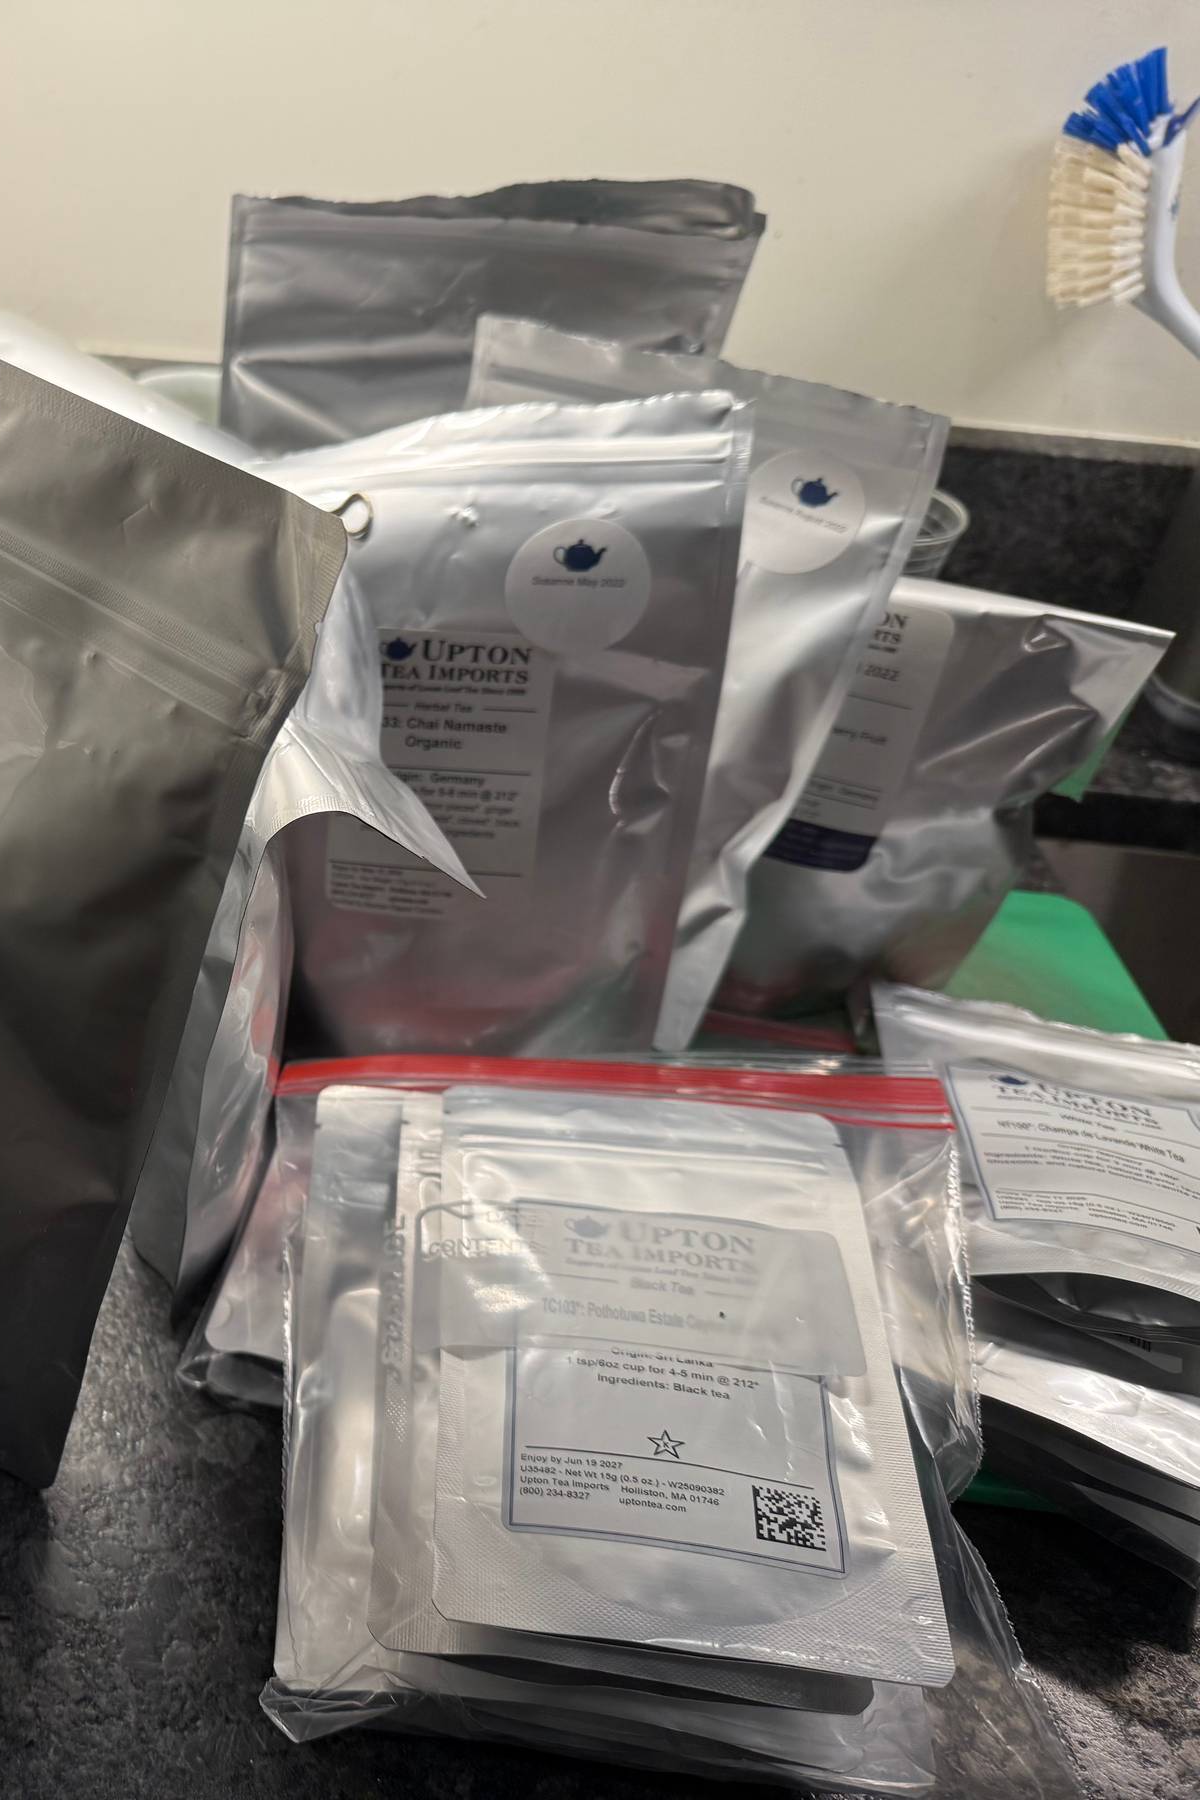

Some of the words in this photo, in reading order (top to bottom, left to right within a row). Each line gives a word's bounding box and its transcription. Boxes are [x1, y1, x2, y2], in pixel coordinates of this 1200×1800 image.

[421, 638, 532, 666] UPTON
[429, 664, 530, 685] IMPORTS
[405, 716, 439, 731] Chai
[442, 717, 508, 734] Namaste
[404, 734, 464, 751] Organic
[429, 772, 486, 787] Germany
[1036, 1081, 1153, 1118] UPTON
[1166, 1148, 1186, 1164] Tea
[618, 1218, 755, 1254] UPTON
[564, 1237, 624, 1259] TEA
[632, 1246, 759, 1275] IMPORTS
[630, 1276, 666, 1291] Black
[669, 1281, 695, 1296] Tea
[648, 1308, 685, 1328] Estate
[576, 1356, 619, 1370] tsp/6oz
[623, 1362, 646, 1374] cup
[648, 1364, 666, 1375] for
[668, 1367, 688, 1379] 4-5
[690, 1371, 714, 1382] min
[716, 1375, 730, 1387] @
[597, 1373, 670, 1391] Ingredients:
[673, 1382, 708, 1396] Black
[710, 1388, 731, 1400] tea
[520, 1453, 547, 1463] Enjoy
[550, 1455, 561, 1464] by
[564, 1456, 582, 1465] Jun
[585, 1458, 597, 1467] 19
[599, 1459, 624, 1469] 2027
[520, 1465, 557, 1475] U35482
[564, 1468, 582, 1477] Net
[583, 1470, 598, 1479] Wt
[600, 1472, 618, 1482] 15g
[620, 1474, 639, 1484] (0.5
[667, 1480, 725, 1496] W25090382
[520, 1475, 549, 1486] Upton
[551, 1477, 570, 1487] Tea
[572, 1479, 610, 1491] Imports
[620, 1485, 669, 1499] Holliston,
[670, 1492, 687, 1501] MA
[689, 1495, 720, 1506] 01746
[519, 1486, 544, 1497] (800)
[546, 1488, 591, 1500] 234-8327
[618, 1497, 687, 1512] uptontea.com
